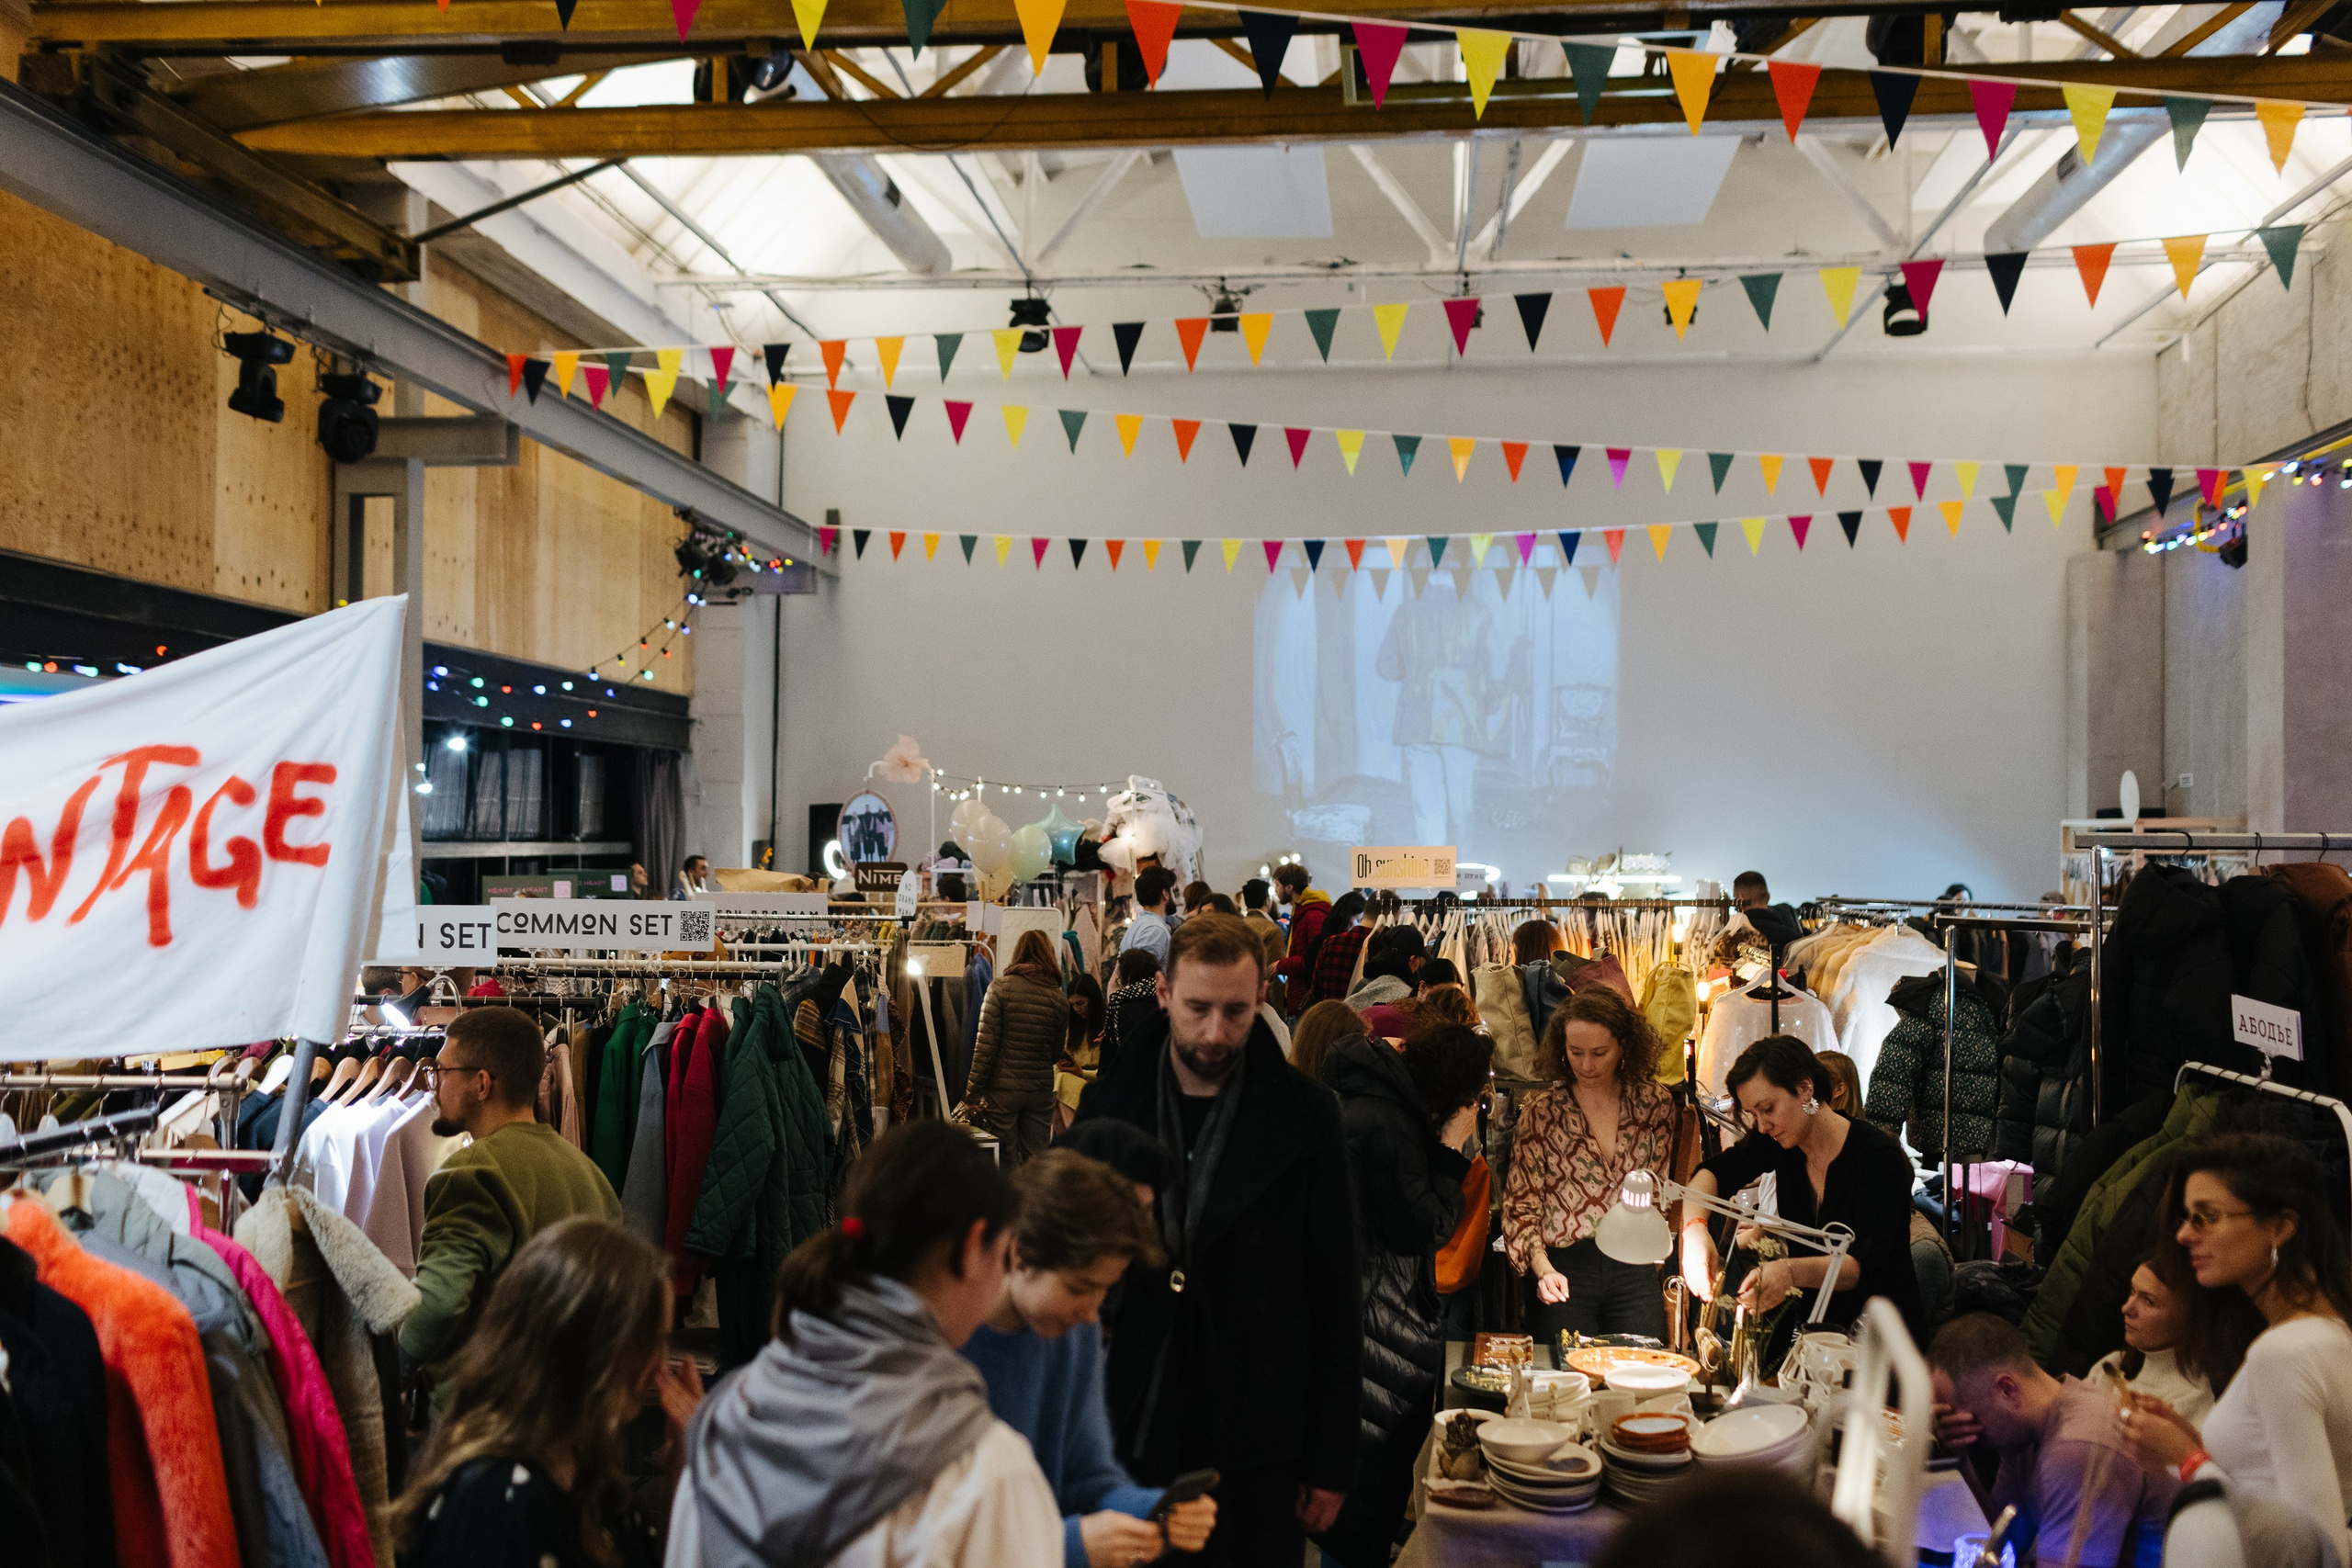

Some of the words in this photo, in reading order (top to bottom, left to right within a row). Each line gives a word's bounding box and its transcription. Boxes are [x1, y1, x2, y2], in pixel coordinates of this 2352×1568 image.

[0, 744, 337, 948] NTAGE
[1357, 853, 1372, 878] Oh
[1375, 853, 1430, 878] sunshine
[440, 923, 491, 948] SET
[497, 912, 616, 935] COMMON
[630, 914, 673, 935] SET
[2238, 1014, 2293, 1046] АБОДЬЕ
